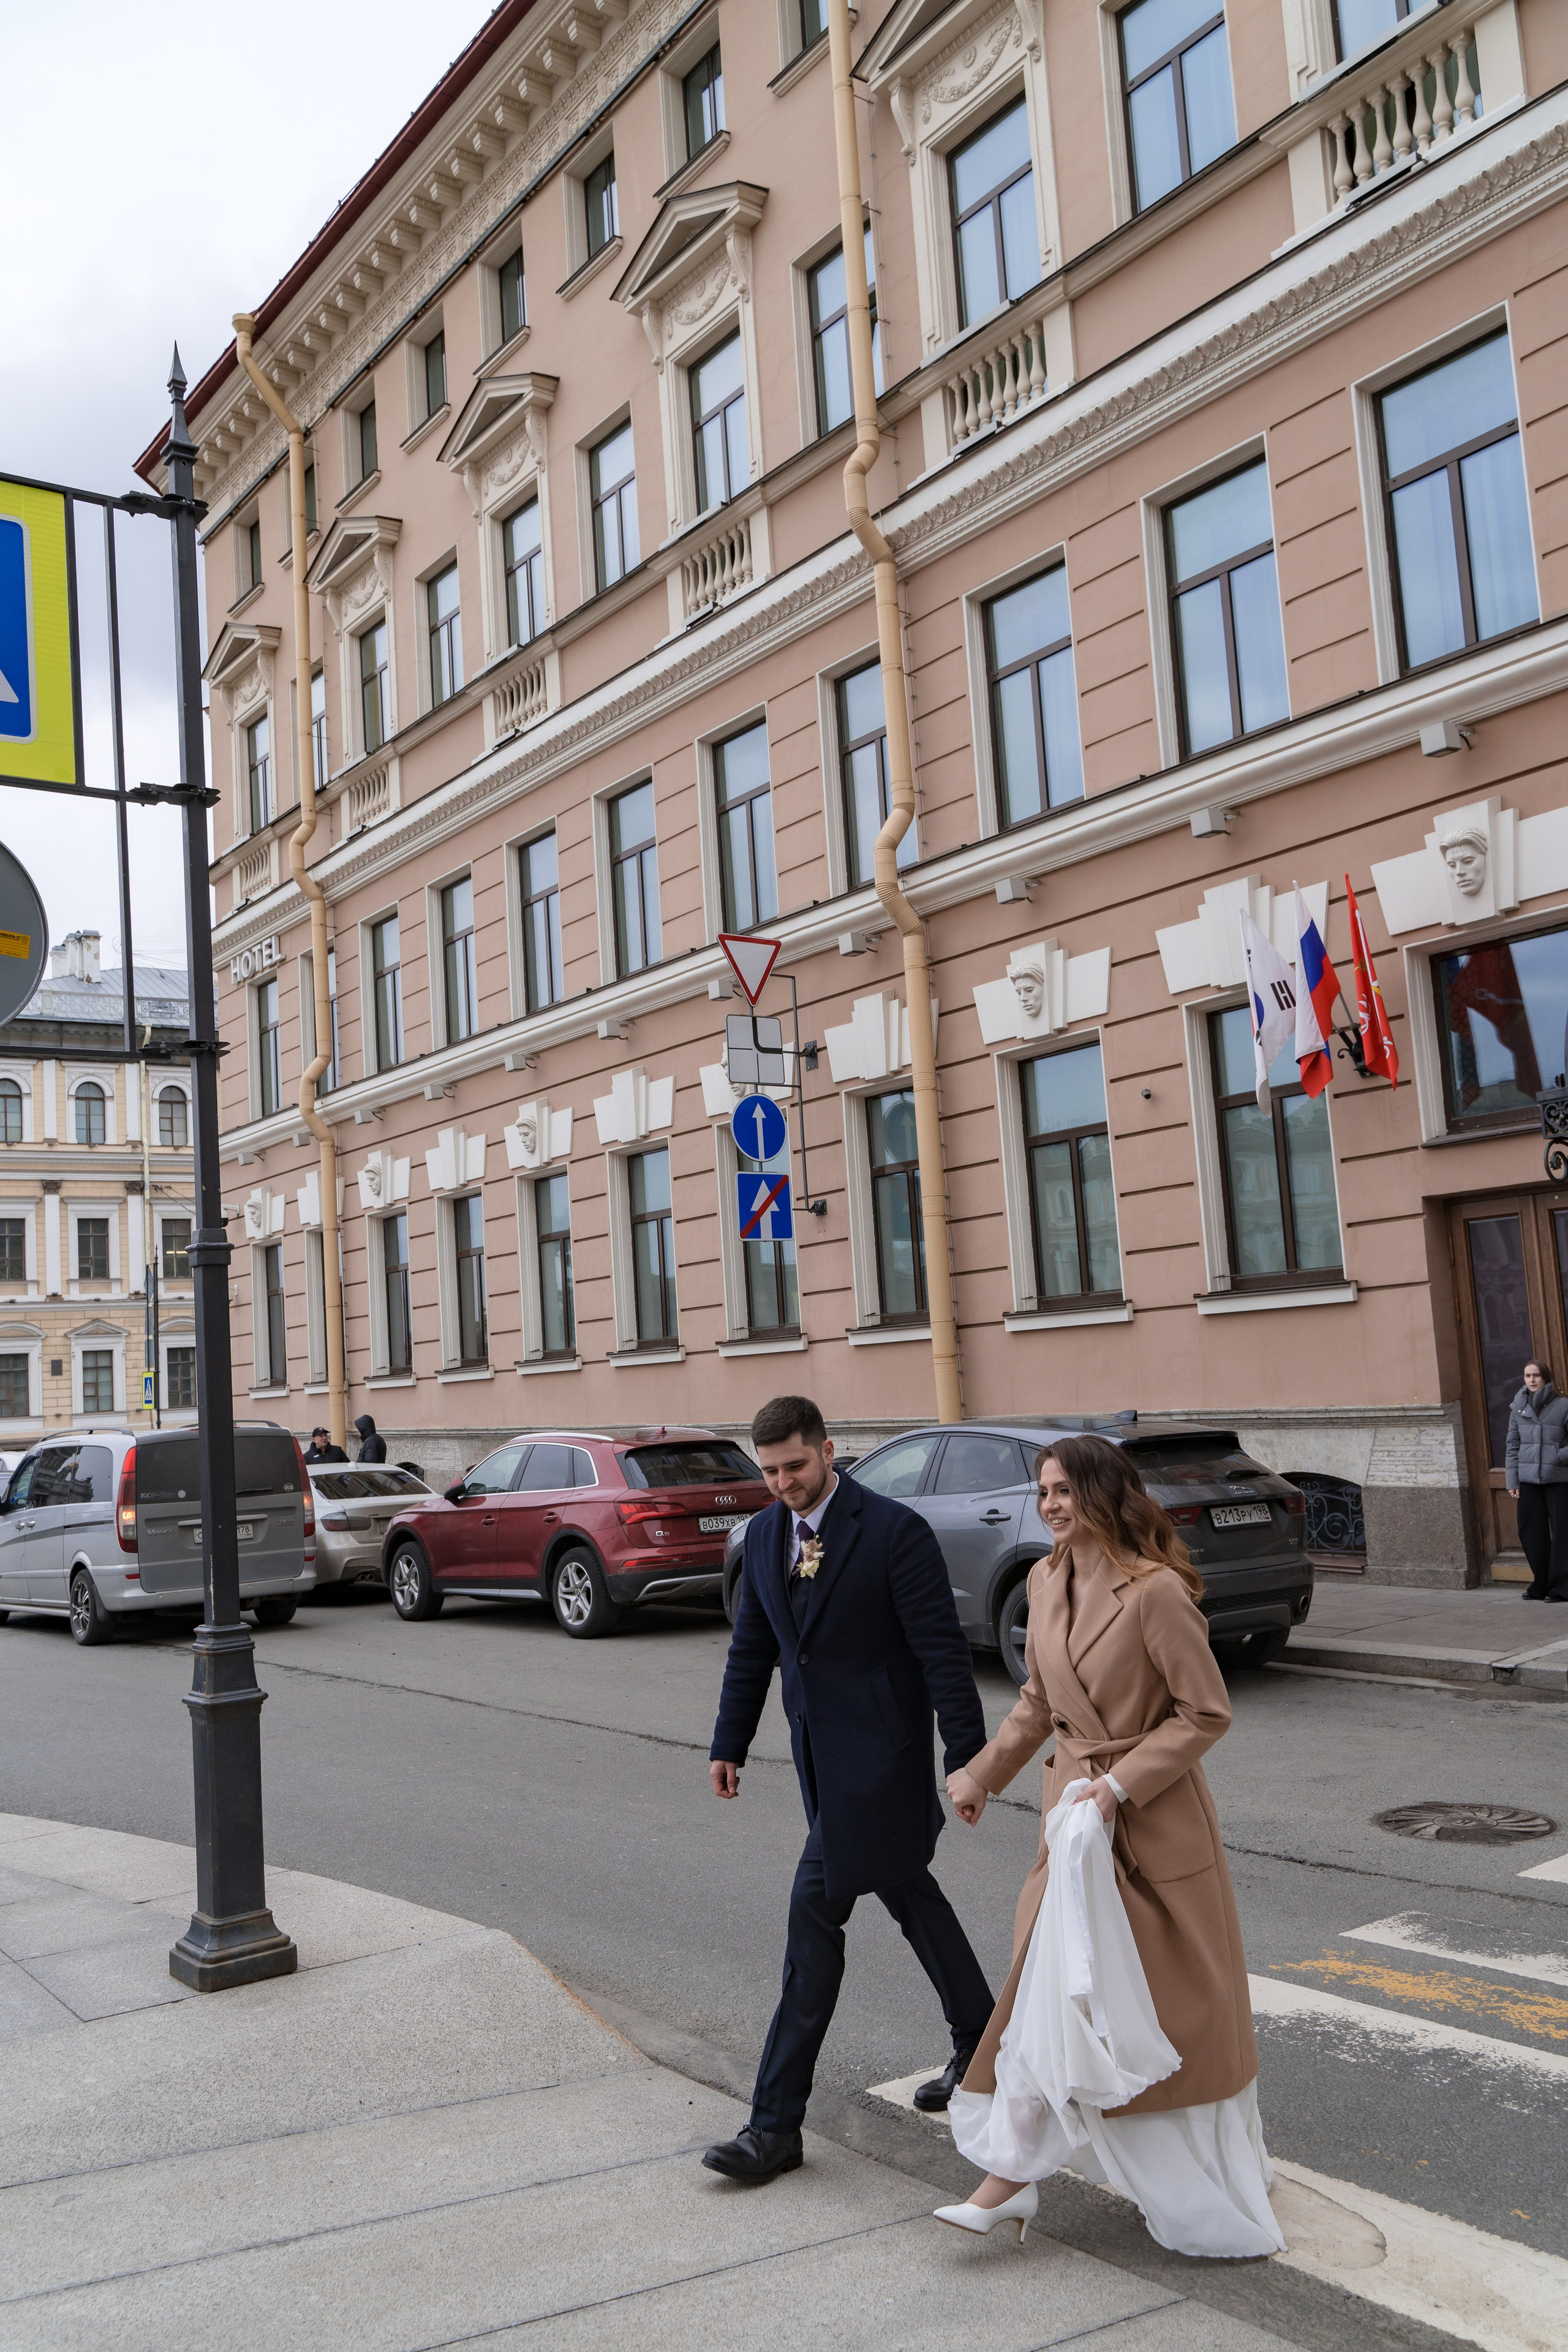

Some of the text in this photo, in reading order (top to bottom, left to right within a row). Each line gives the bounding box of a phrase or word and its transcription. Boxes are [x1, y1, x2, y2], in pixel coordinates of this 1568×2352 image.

[230, 936, 286, 984] HOTEL
[1253, 1504, 1267, 1516] 198
[237, 1525, 249, 1534] 178
